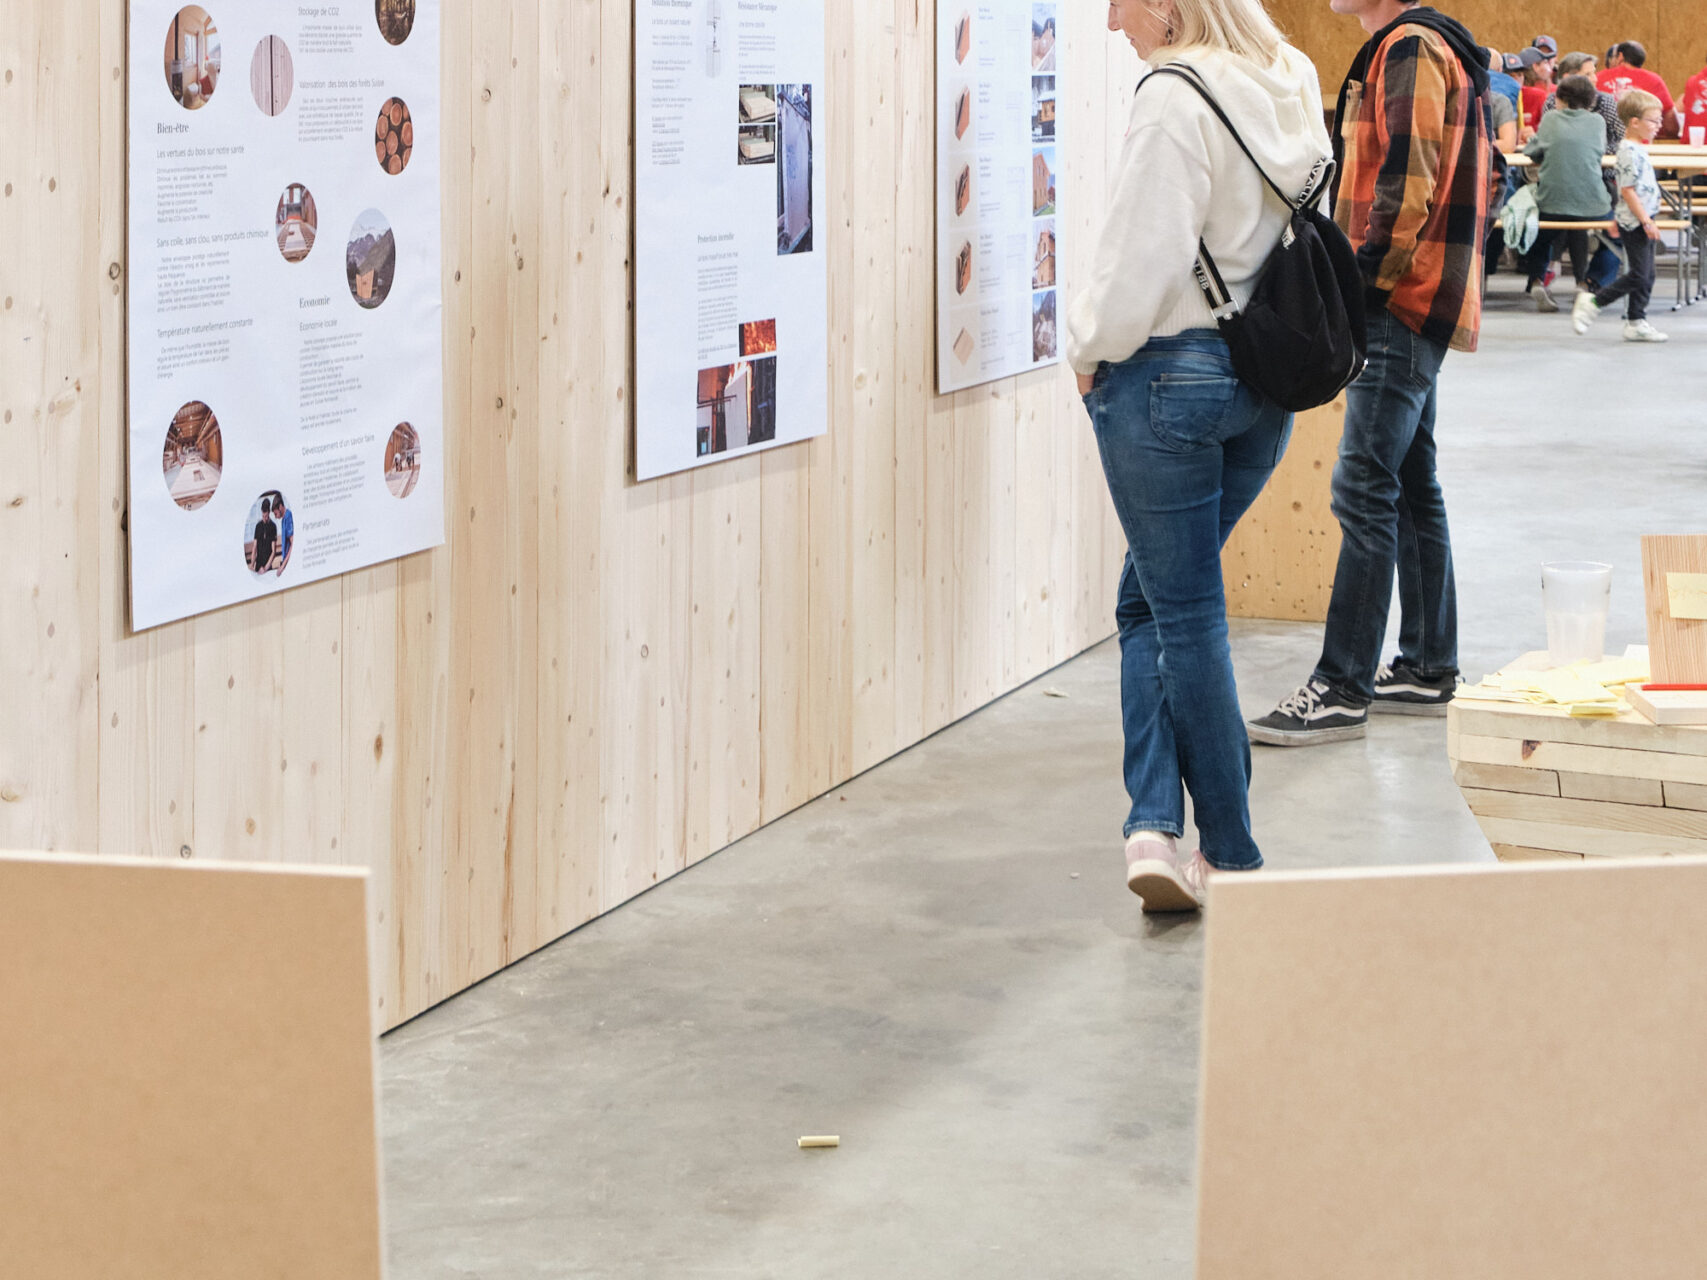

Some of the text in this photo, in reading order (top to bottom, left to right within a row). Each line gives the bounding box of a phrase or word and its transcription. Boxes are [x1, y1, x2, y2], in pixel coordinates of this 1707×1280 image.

[298, 7, 340, 17] Stockage de CO2
[157, 122, 189, 135] Bien-être
[157, 145, 245, 158] Les vertues du bois sur notre santé
[157, 238, 169, 249] Sans
[185, 236, 197, 246] sans
[212, 234, 223, 243] sans
[224, 231, 245, 243] produits
[246, 229, 269, 241] chimique
[299, 295, 330, 309] Economie
[157, 317, 253, 341] Température naturellement constante
